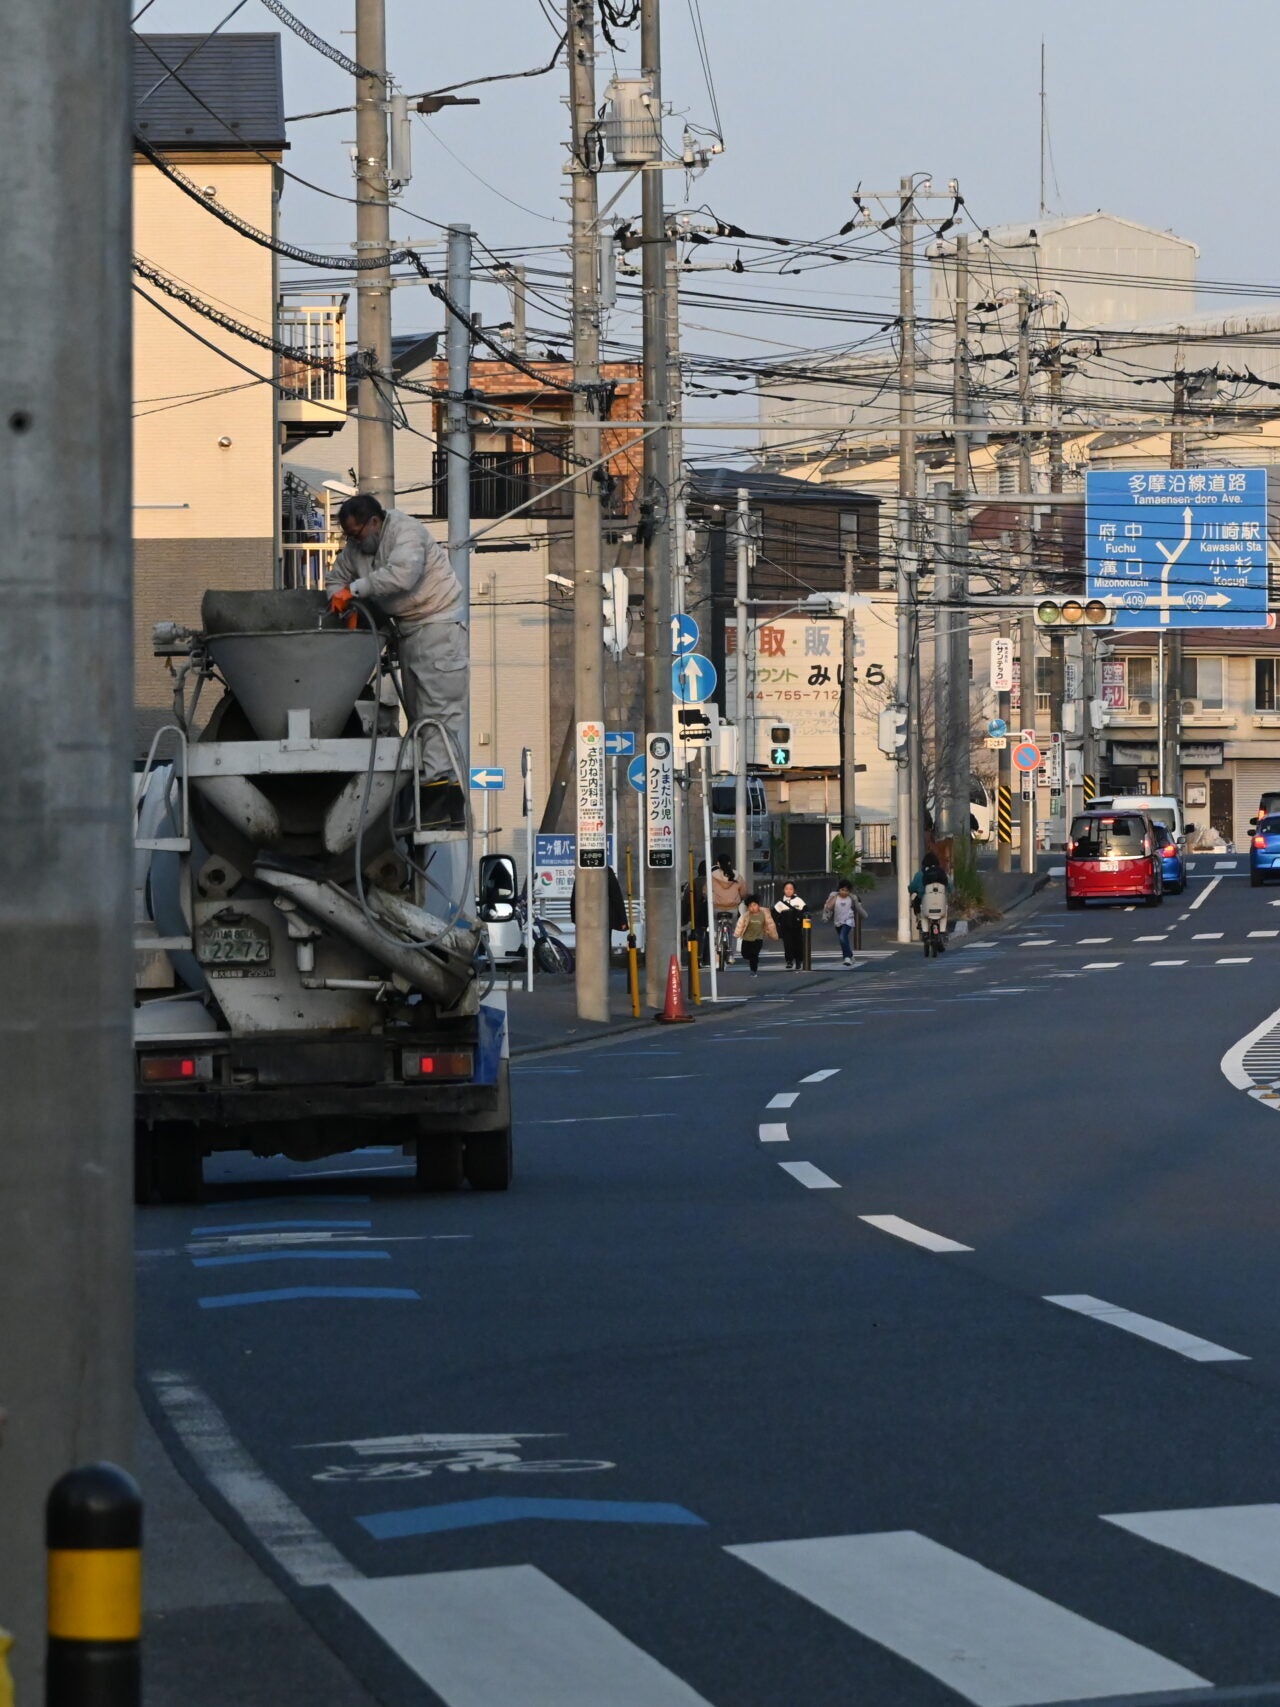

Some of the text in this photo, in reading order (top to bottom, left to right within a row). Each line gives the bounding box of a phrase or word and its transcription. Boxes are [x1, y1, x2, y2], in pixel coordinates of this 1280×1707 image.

[1128, 474, 1246, 493] 多摩沿線道路
[1133, 493, 1243, 504] Tamaensen-doro Ave.
[1098, 522, 1142, 542] 府中
[1202, 522, 1261, 540] 川崎駅
[1105, 543, 1136, 554] Fuchu
[1200, 542, 1263, 552] Kawasaki Sta.
[1099, 558, 1142, 576] 溝口
[1209, 556, 1252, 575] 小杉
[1094, 577, 1149, 588] Mizonokuchi
[1214, 576, 1248, 587] Kosugi
[1126, 595, 1144, 605] 409
[1186, 595, 1204, 605] 409
[588, 746, 599, 798] さかね内科
[579, 758, 589, 807] クリニック
[661, 762, 672, 820] しまだ小児
[649, 767, 660, 821] クリニック
